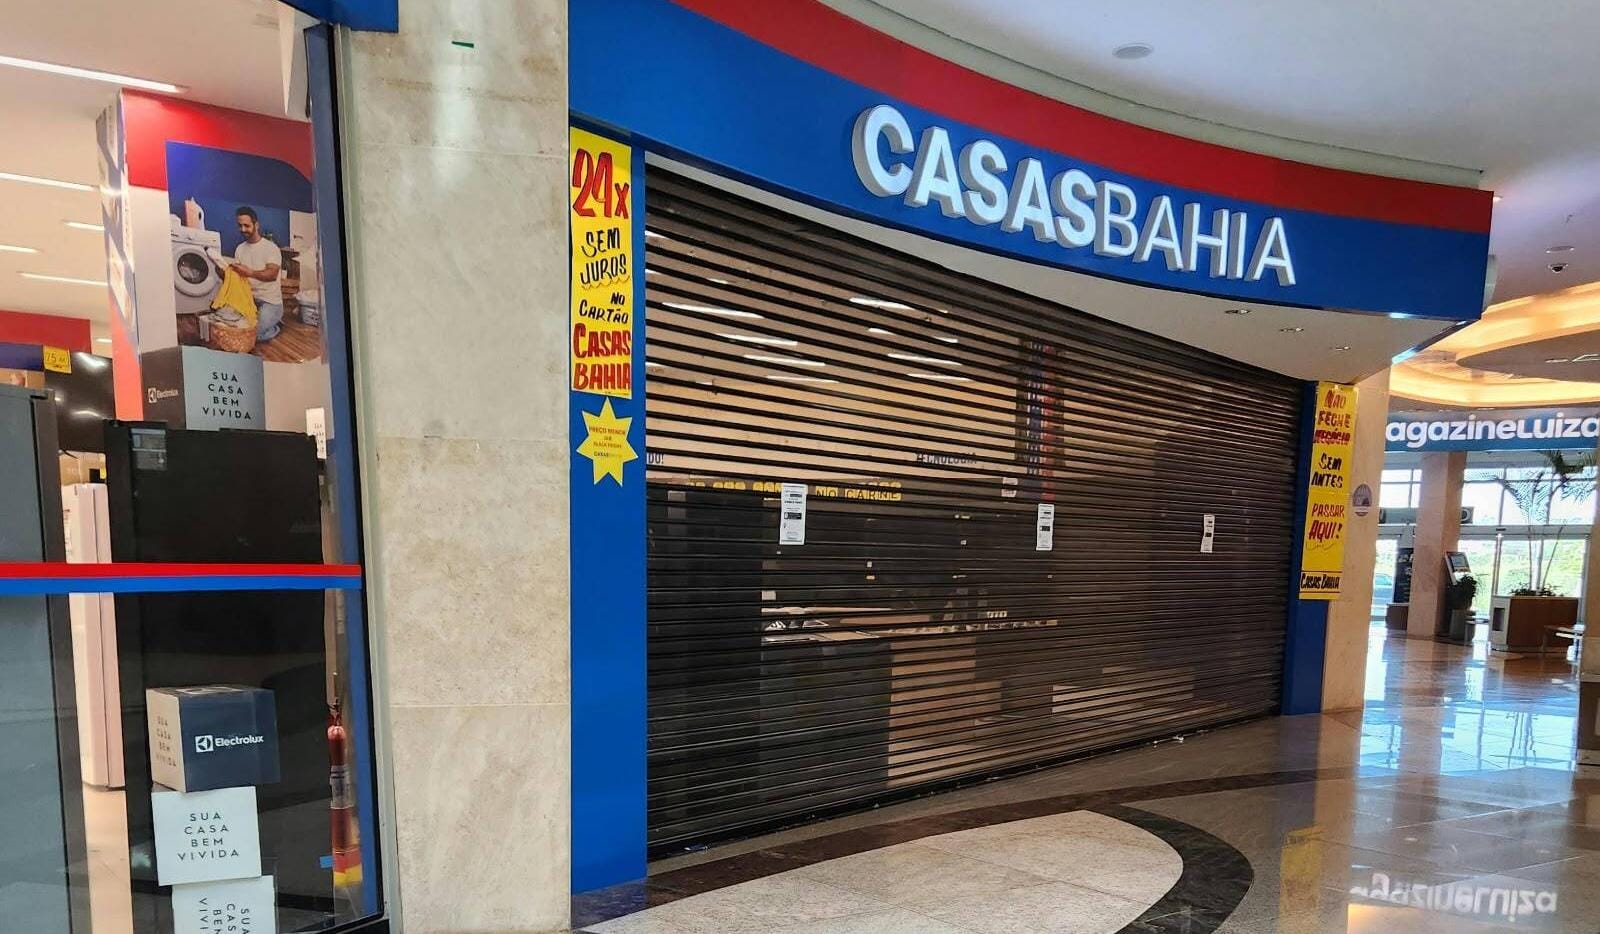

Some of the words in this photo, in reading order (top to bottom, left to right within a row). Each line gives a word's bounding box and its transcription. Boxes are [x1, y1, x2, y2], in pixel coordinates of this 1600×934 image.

[581, 227, 621, 258] SEM
[580, 253, 627, 285] JUROS
[611, 292, 626, 306] NO
[579, 299, 629, 324] CARTÃO
[573, 323, 631, 358] CASAS
[212, 371, 238, 382] SUA
[573, 363, 631, 390] BAHIA
[208, 383, 244, 395] CASA
[213, 396, 239, 407] BEM
[202, 407, 252, 420] VIVIDA
[1319, 453, 1343, 470] SEM
[1311, 472, 1343, 488] ANTES
[214, 734, 264, 747] Electrolux
[189, 812, 221, 822] SUA
[184, 824, 229, 835] CASA
[191, 838, 223, 848] BEM
[177, 849, 240, 860] VIVIDA
